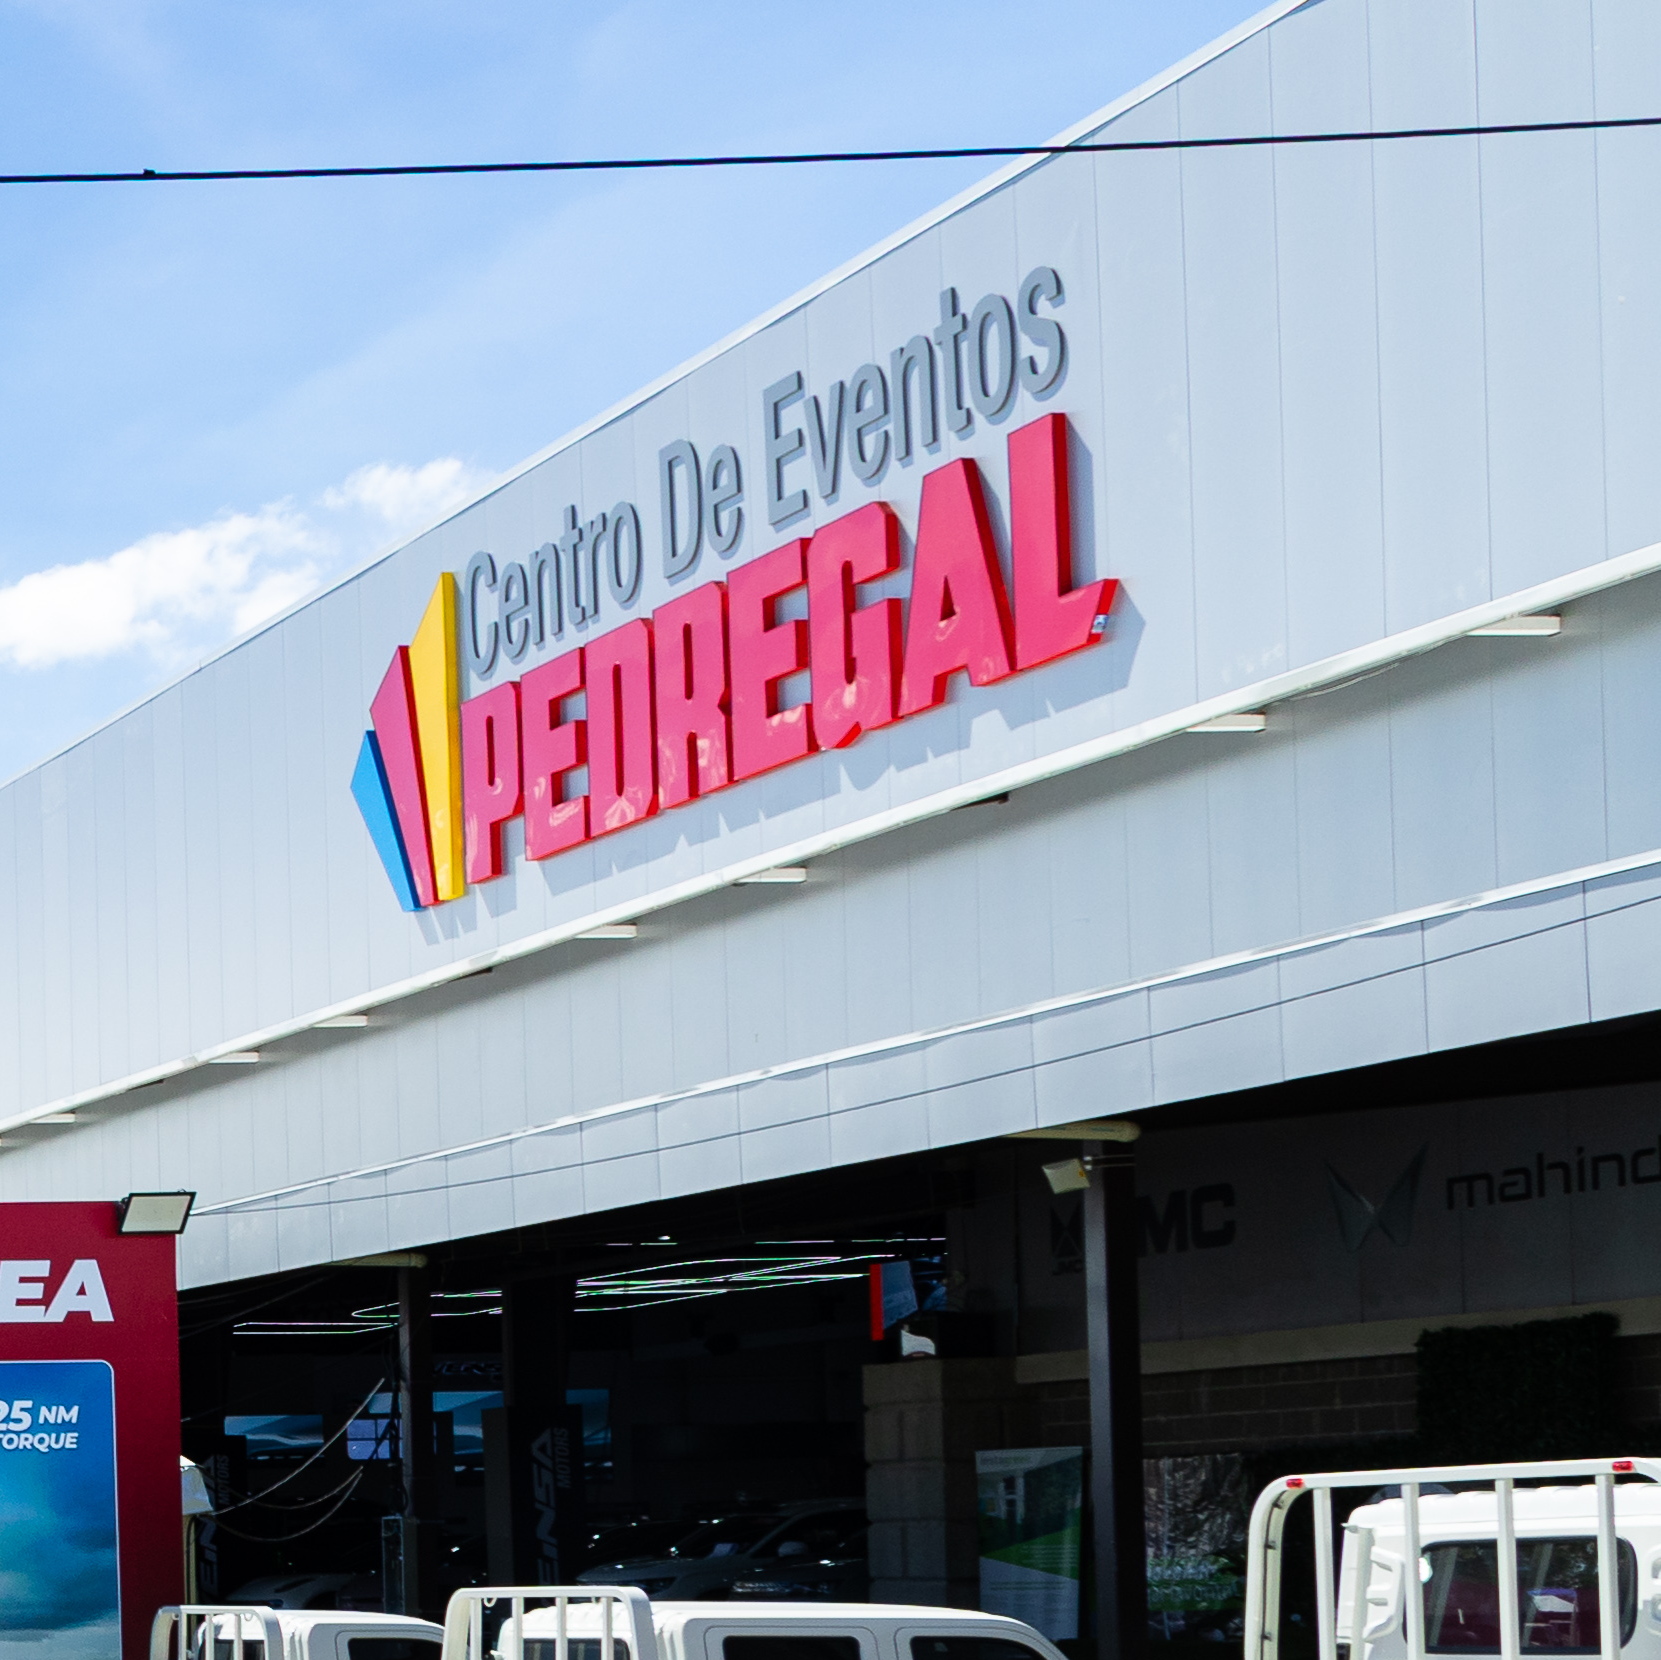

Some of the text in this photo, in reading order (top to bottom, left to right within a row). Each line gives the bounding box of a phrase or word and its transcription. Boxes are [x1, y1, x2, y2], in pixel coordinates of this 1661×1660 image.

[464, 266, 1066, 681] Centro De Eventos
[460, 413, 1119, 884] PEDREGAL
[1136, 1183, 1236, 1258] MC
[38, 1405, 79, 1424] NM
[556, 1426, 571, 1489] MOTORS
[530, 1427, 560, 1588] EINSA
